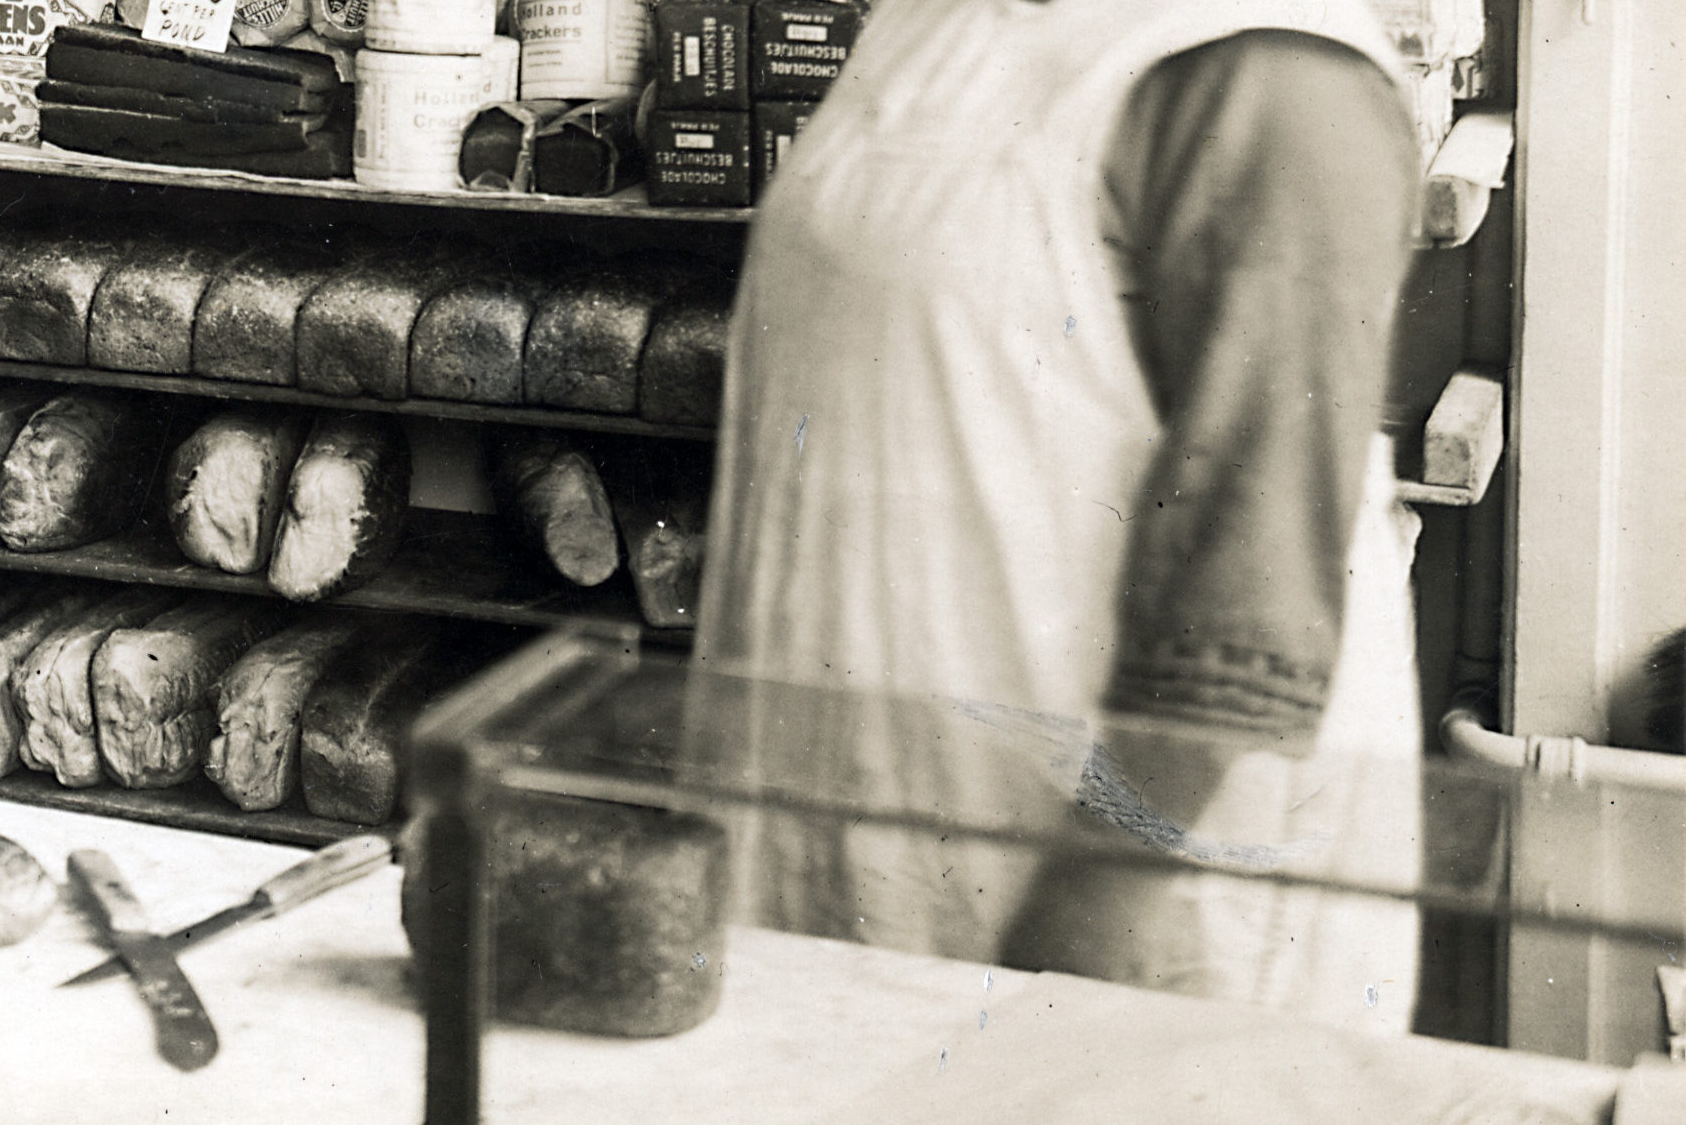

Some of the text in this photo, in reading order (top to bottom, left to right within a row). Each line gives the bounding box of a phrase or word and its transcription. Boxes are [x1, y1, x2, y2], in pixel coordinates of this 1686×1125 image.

[521, 2, 582, 21] olland
[159, 19, 205, 41] POND
[702, 17, 718, 97] BESCHUITJES
[721, 24, 735, 91] CHOCOLADE
[764, 42, 846, 61] BESCHUITJES
[770, 61, 838, 78] CHOCOLADE
[655, 151, 733, 167] BESCHUITJES
[661, 171, 726, 185] CHOCOLADE
